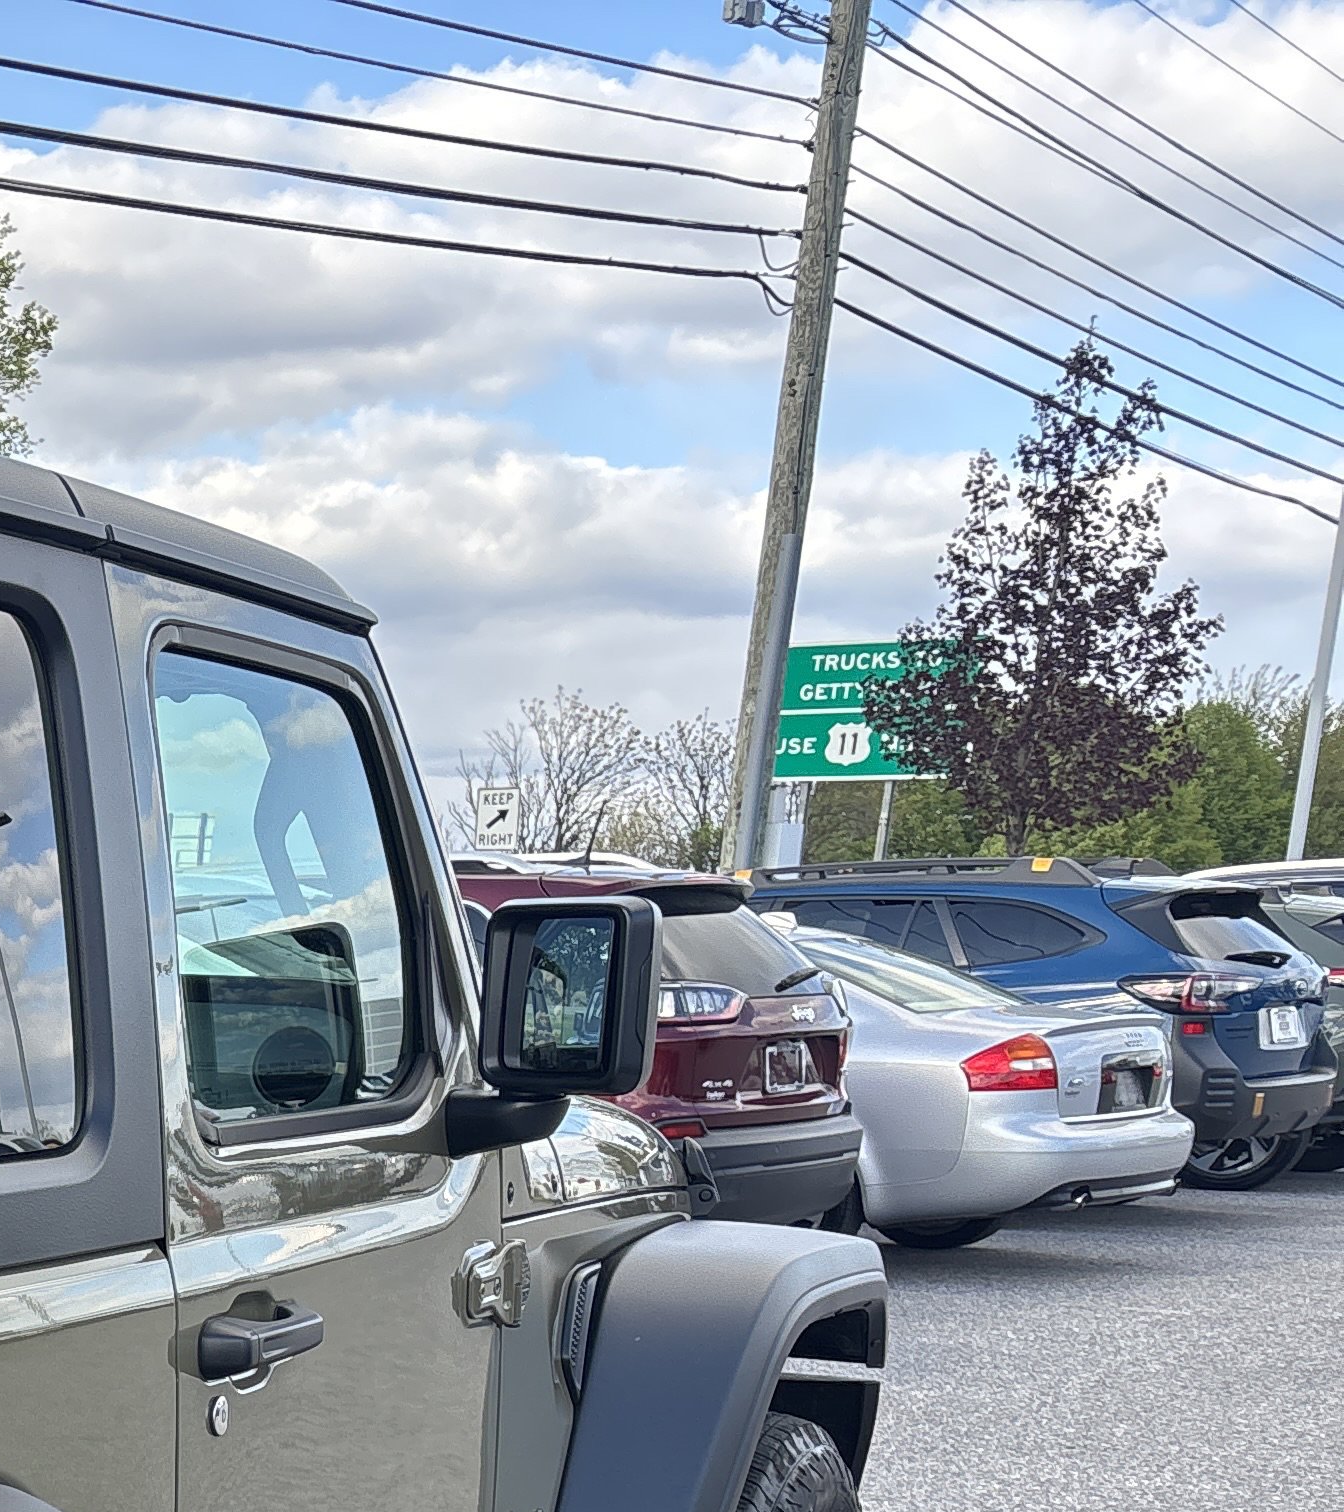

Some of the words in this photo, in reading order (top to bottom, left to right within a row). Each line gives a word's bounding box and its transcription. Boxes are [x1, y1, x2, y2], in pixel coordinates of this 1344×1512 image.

[812, 651, 901, 672] TRUCKS
[838, 731, 858, 756] 11
[483, 792, 514, 806] KEEP
[478, 832, 514, 846] RIGHT
